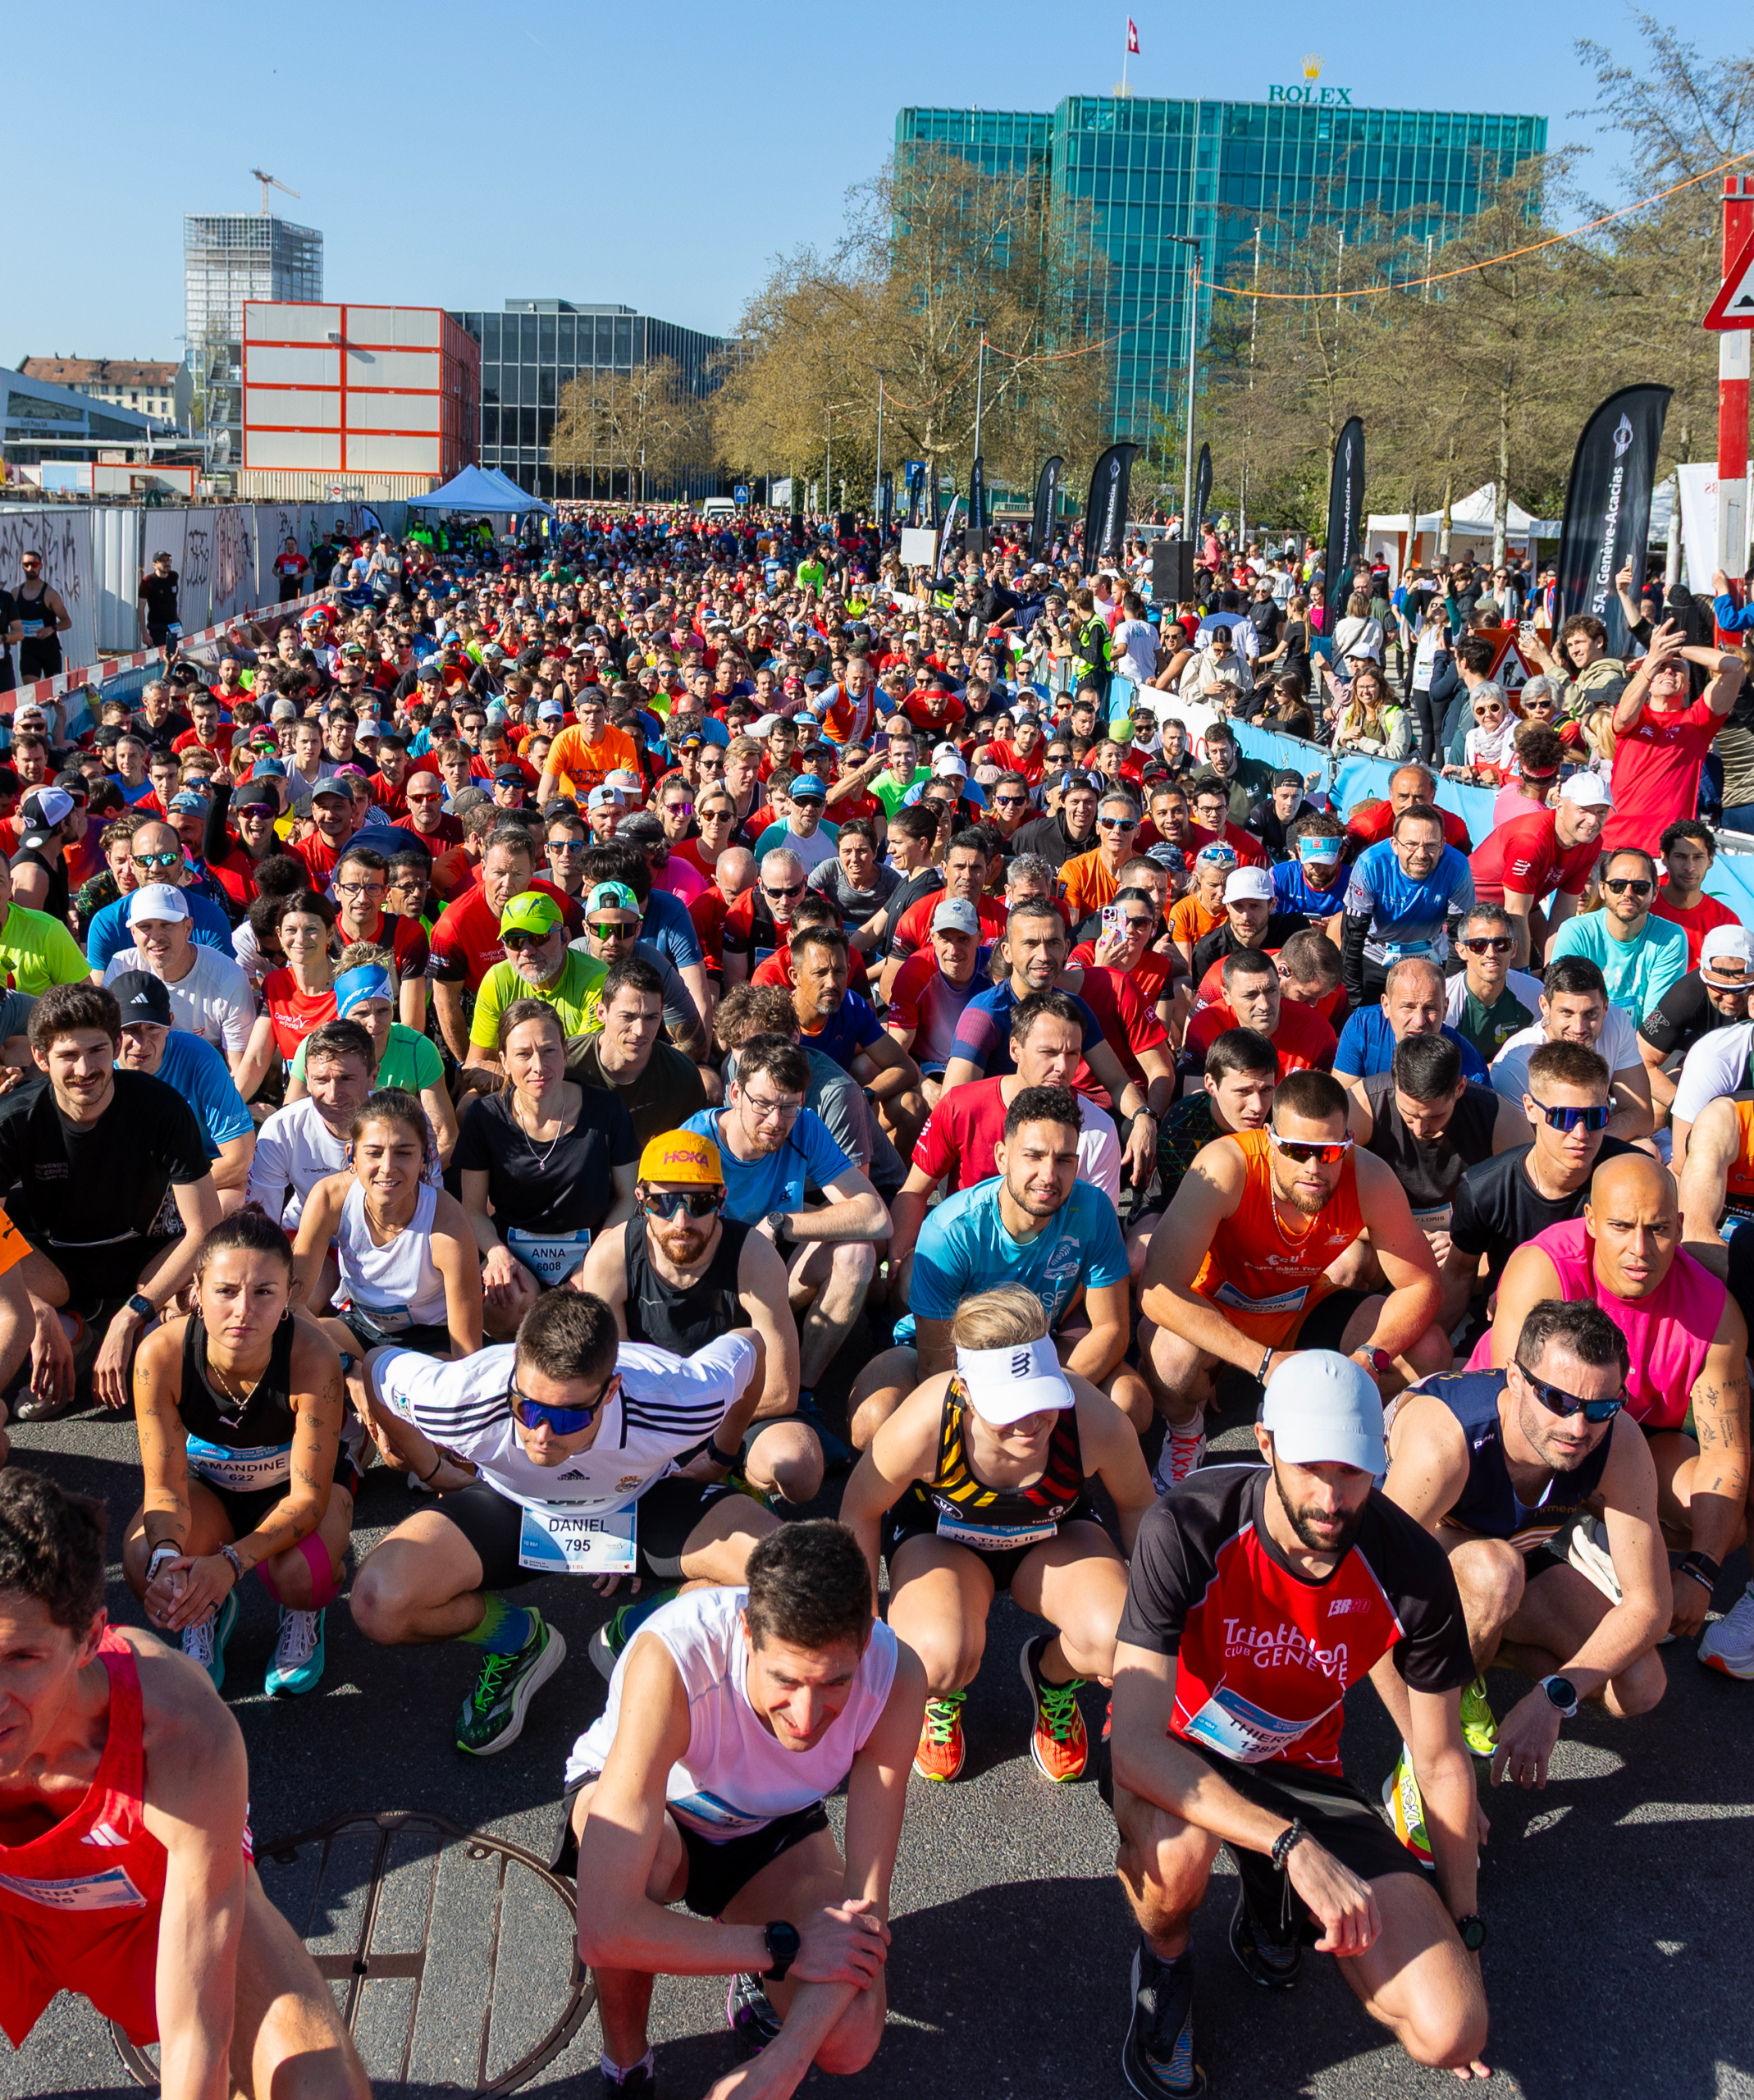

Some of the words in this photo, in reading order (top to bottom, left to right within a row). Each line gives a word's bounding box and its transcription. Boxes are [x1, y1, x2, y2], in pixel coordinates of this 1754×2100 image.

[1268, 84, 1353, 104] ROLEX
[1596, 465, 1624, 586] Genève-Acacias
[274, 1011, 293, 1022] Course
[284, 1020, 299, 1029] Ponts
[663, 1150, 710, 1168] HOKA
[532, 1249, 566, 1258] ANNA
[537, 1262, 561, 1271] 6008
[1235, 1299, 1286, 1310] ROMAIN
[199, 1458, 285, 1472] AMANDINE
[549, 1519, 610, 1532] DANIEL
[953, 1533, 1039, 1543] NATHALIE
[565, 1539, 591, 1551] 795
[1223, 1618, 1348, 1664] Triathlon
[1225, 1646, 1251, 1658] CLUB
[1400, 1775, 1422, 1835] HOKA
